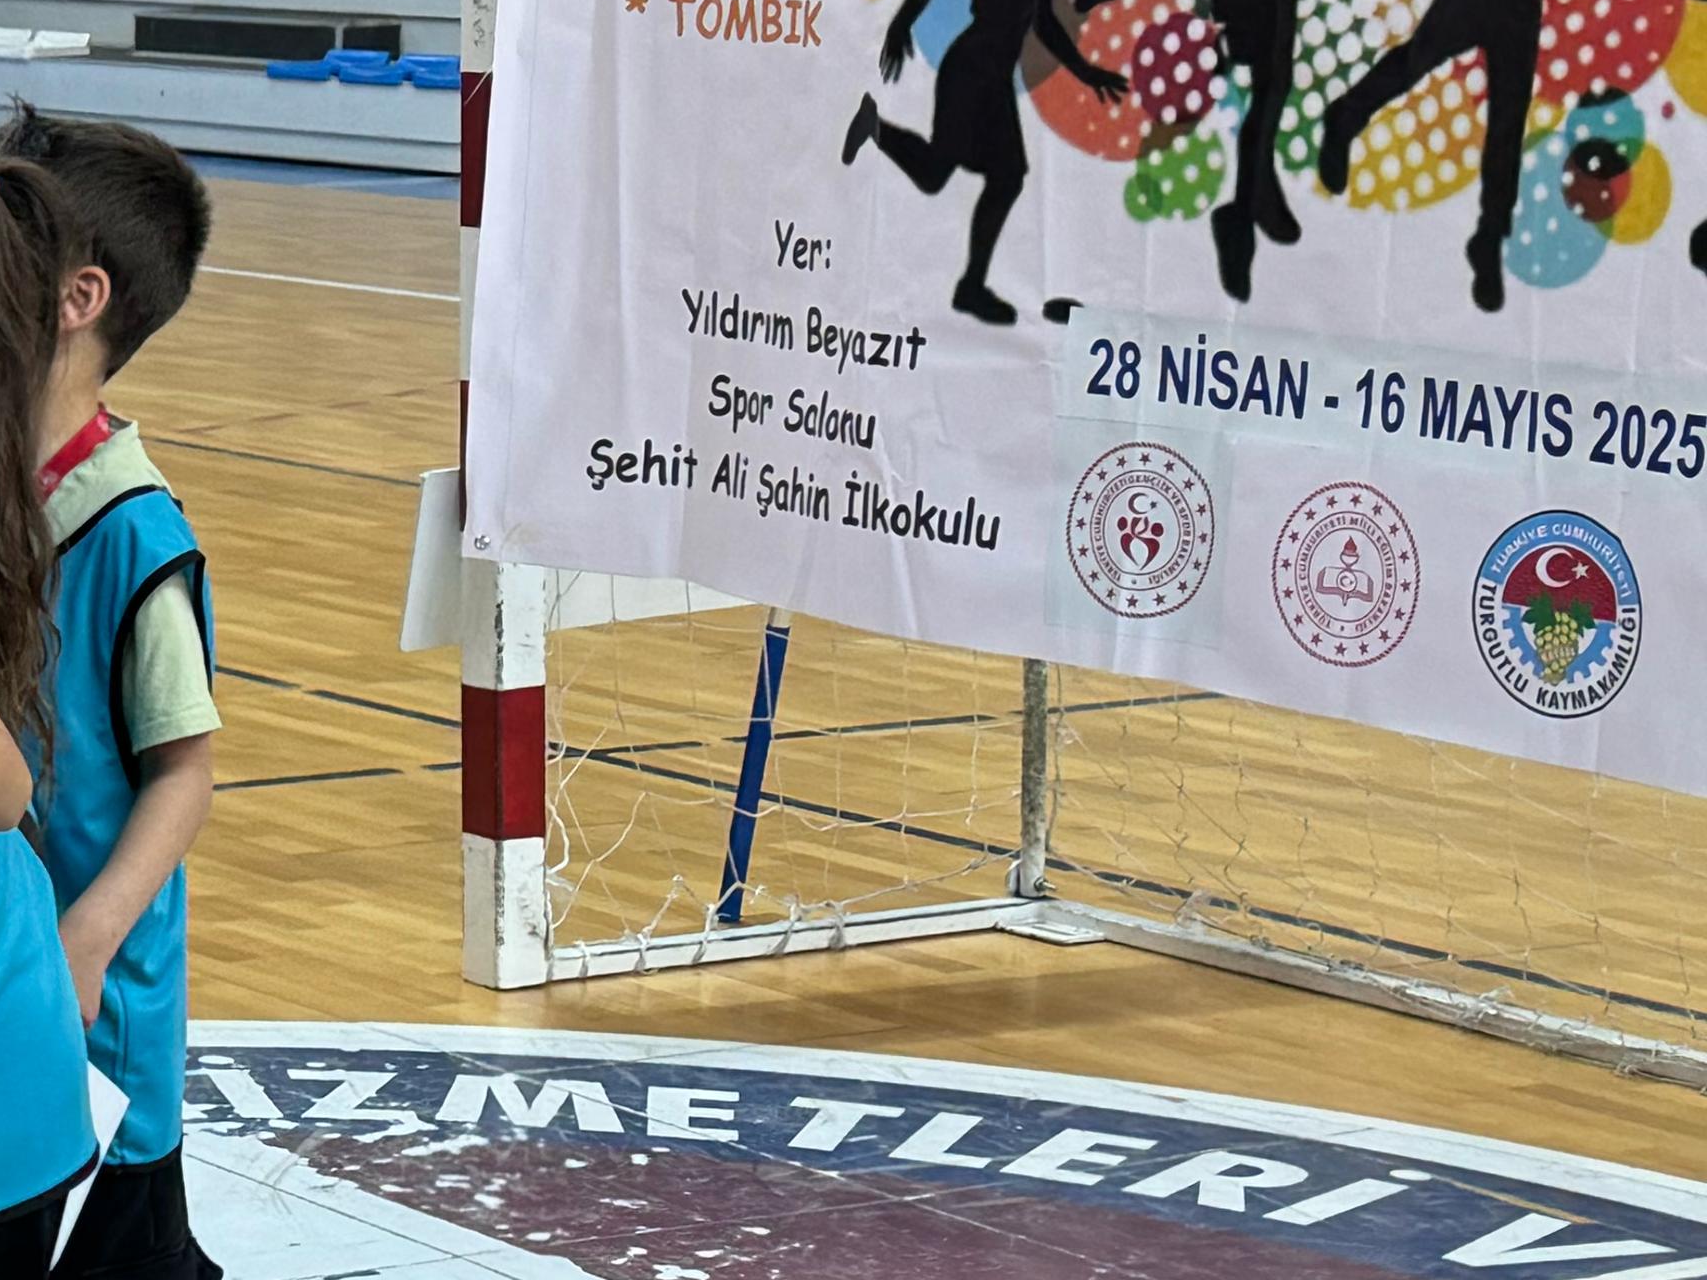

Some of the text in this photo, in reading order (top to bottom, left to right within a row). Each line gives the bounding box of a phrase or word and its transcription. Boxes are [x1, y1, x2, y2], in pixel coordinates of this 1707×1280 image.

[775, 220, 832, 272] Yer:
[682, 288, 926, 374] Yıldırım Beyazıt
[708, 375, 876, 449] Spor Salonu
[1087, 338, 1142, 399] 28
[1158, 333, 1309, 419] NİSAN
[1355, 368, 1406, 433] 16
[1419, 376, 1573, 458] MAYIS
[1589, 401, 1707, 479] 2025
[587, 439, 1000, 551] Şehit Ali Şahin İlkokulu
[1479, 583, 1637, 711] TURGUTLU KAYMAKAMLIĞI
